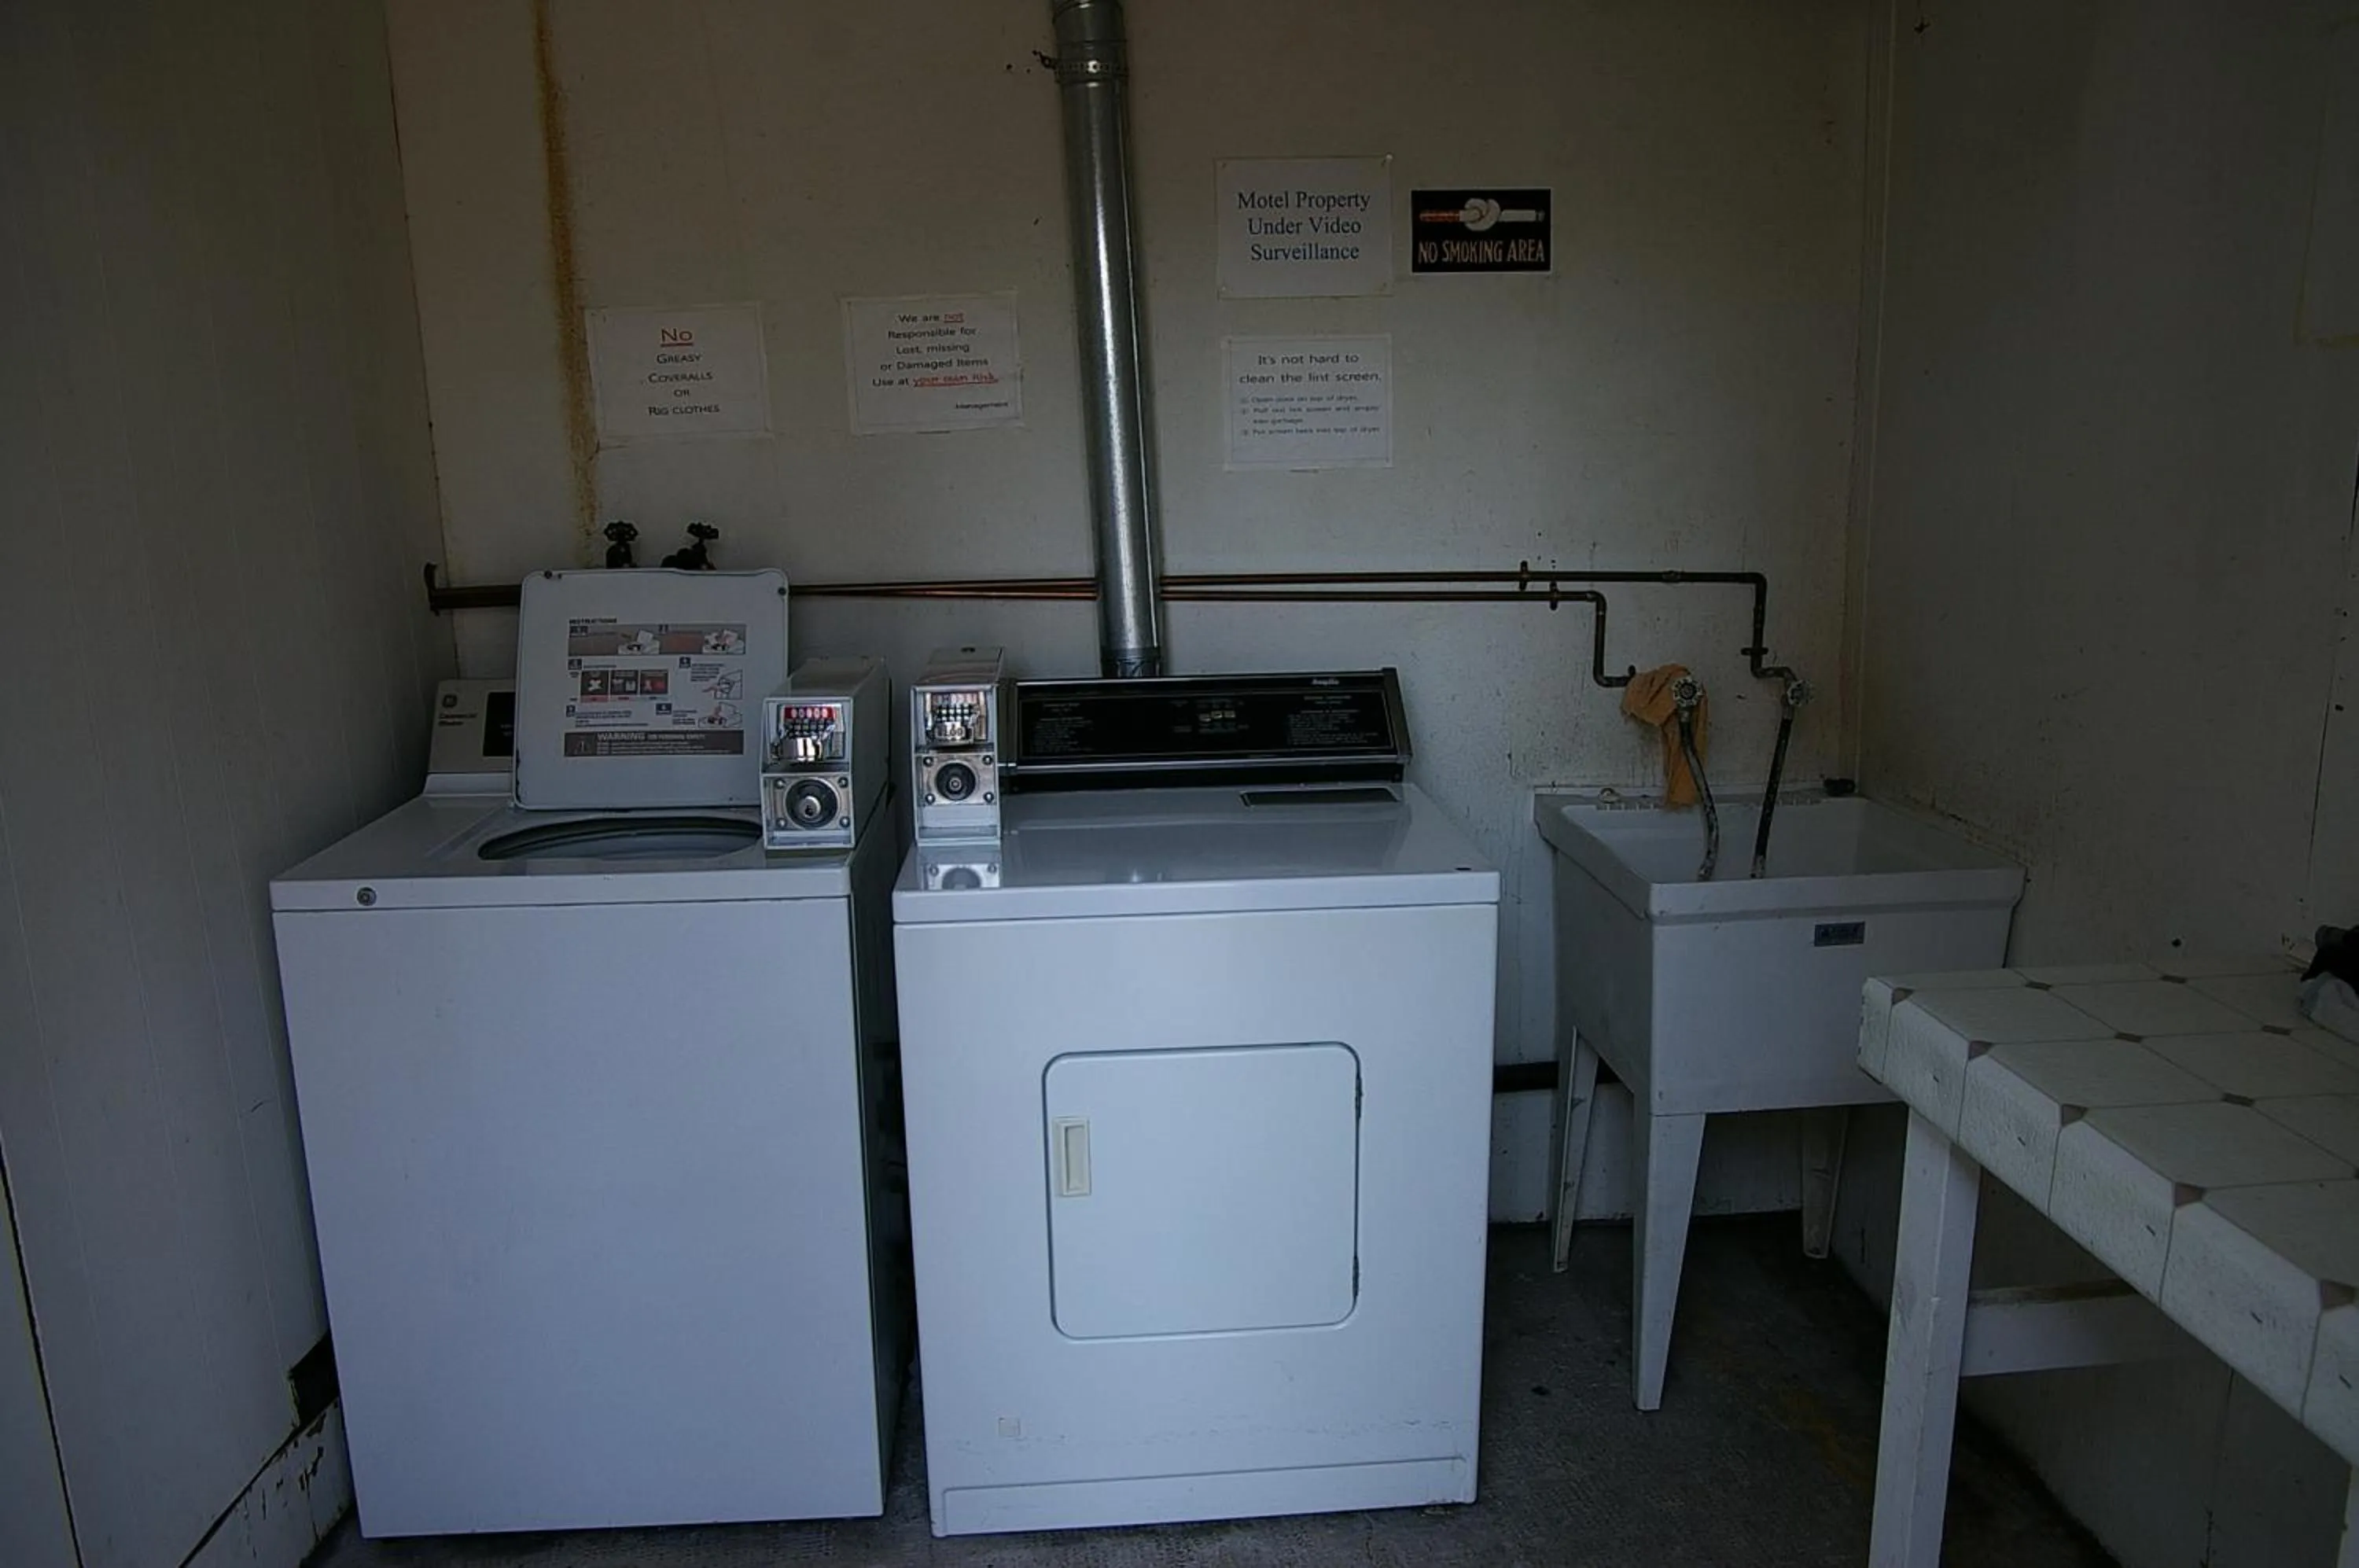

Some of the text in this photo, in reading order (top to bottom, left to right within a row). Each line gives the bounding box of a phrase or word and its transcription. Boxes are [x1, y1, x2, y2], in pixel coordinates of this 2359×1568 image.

[1238, 190, 1371, 212] Motel Property
[1247, 215, 1361, 234] Under Video
[1251, 241, 1360, 260] Surveillance
[1418, 238, 1545, 264] NO SMOKING AREA
[898, 314, 918, 322] We
[888, 326, 976, 340] Responsible for
[927, 344, 970, 353] missing
[896, 359, 952, 371] Damaged
[957, 359, 988, 367] Items
[1258, 354, 1360, 366] It's not hard to
[1239, 374, 1275, 385] clean
[1281, 373, 1302, 383] the
[1308, 372, 1329, 382] lint
[597, 732, 646, 742] WARNING
